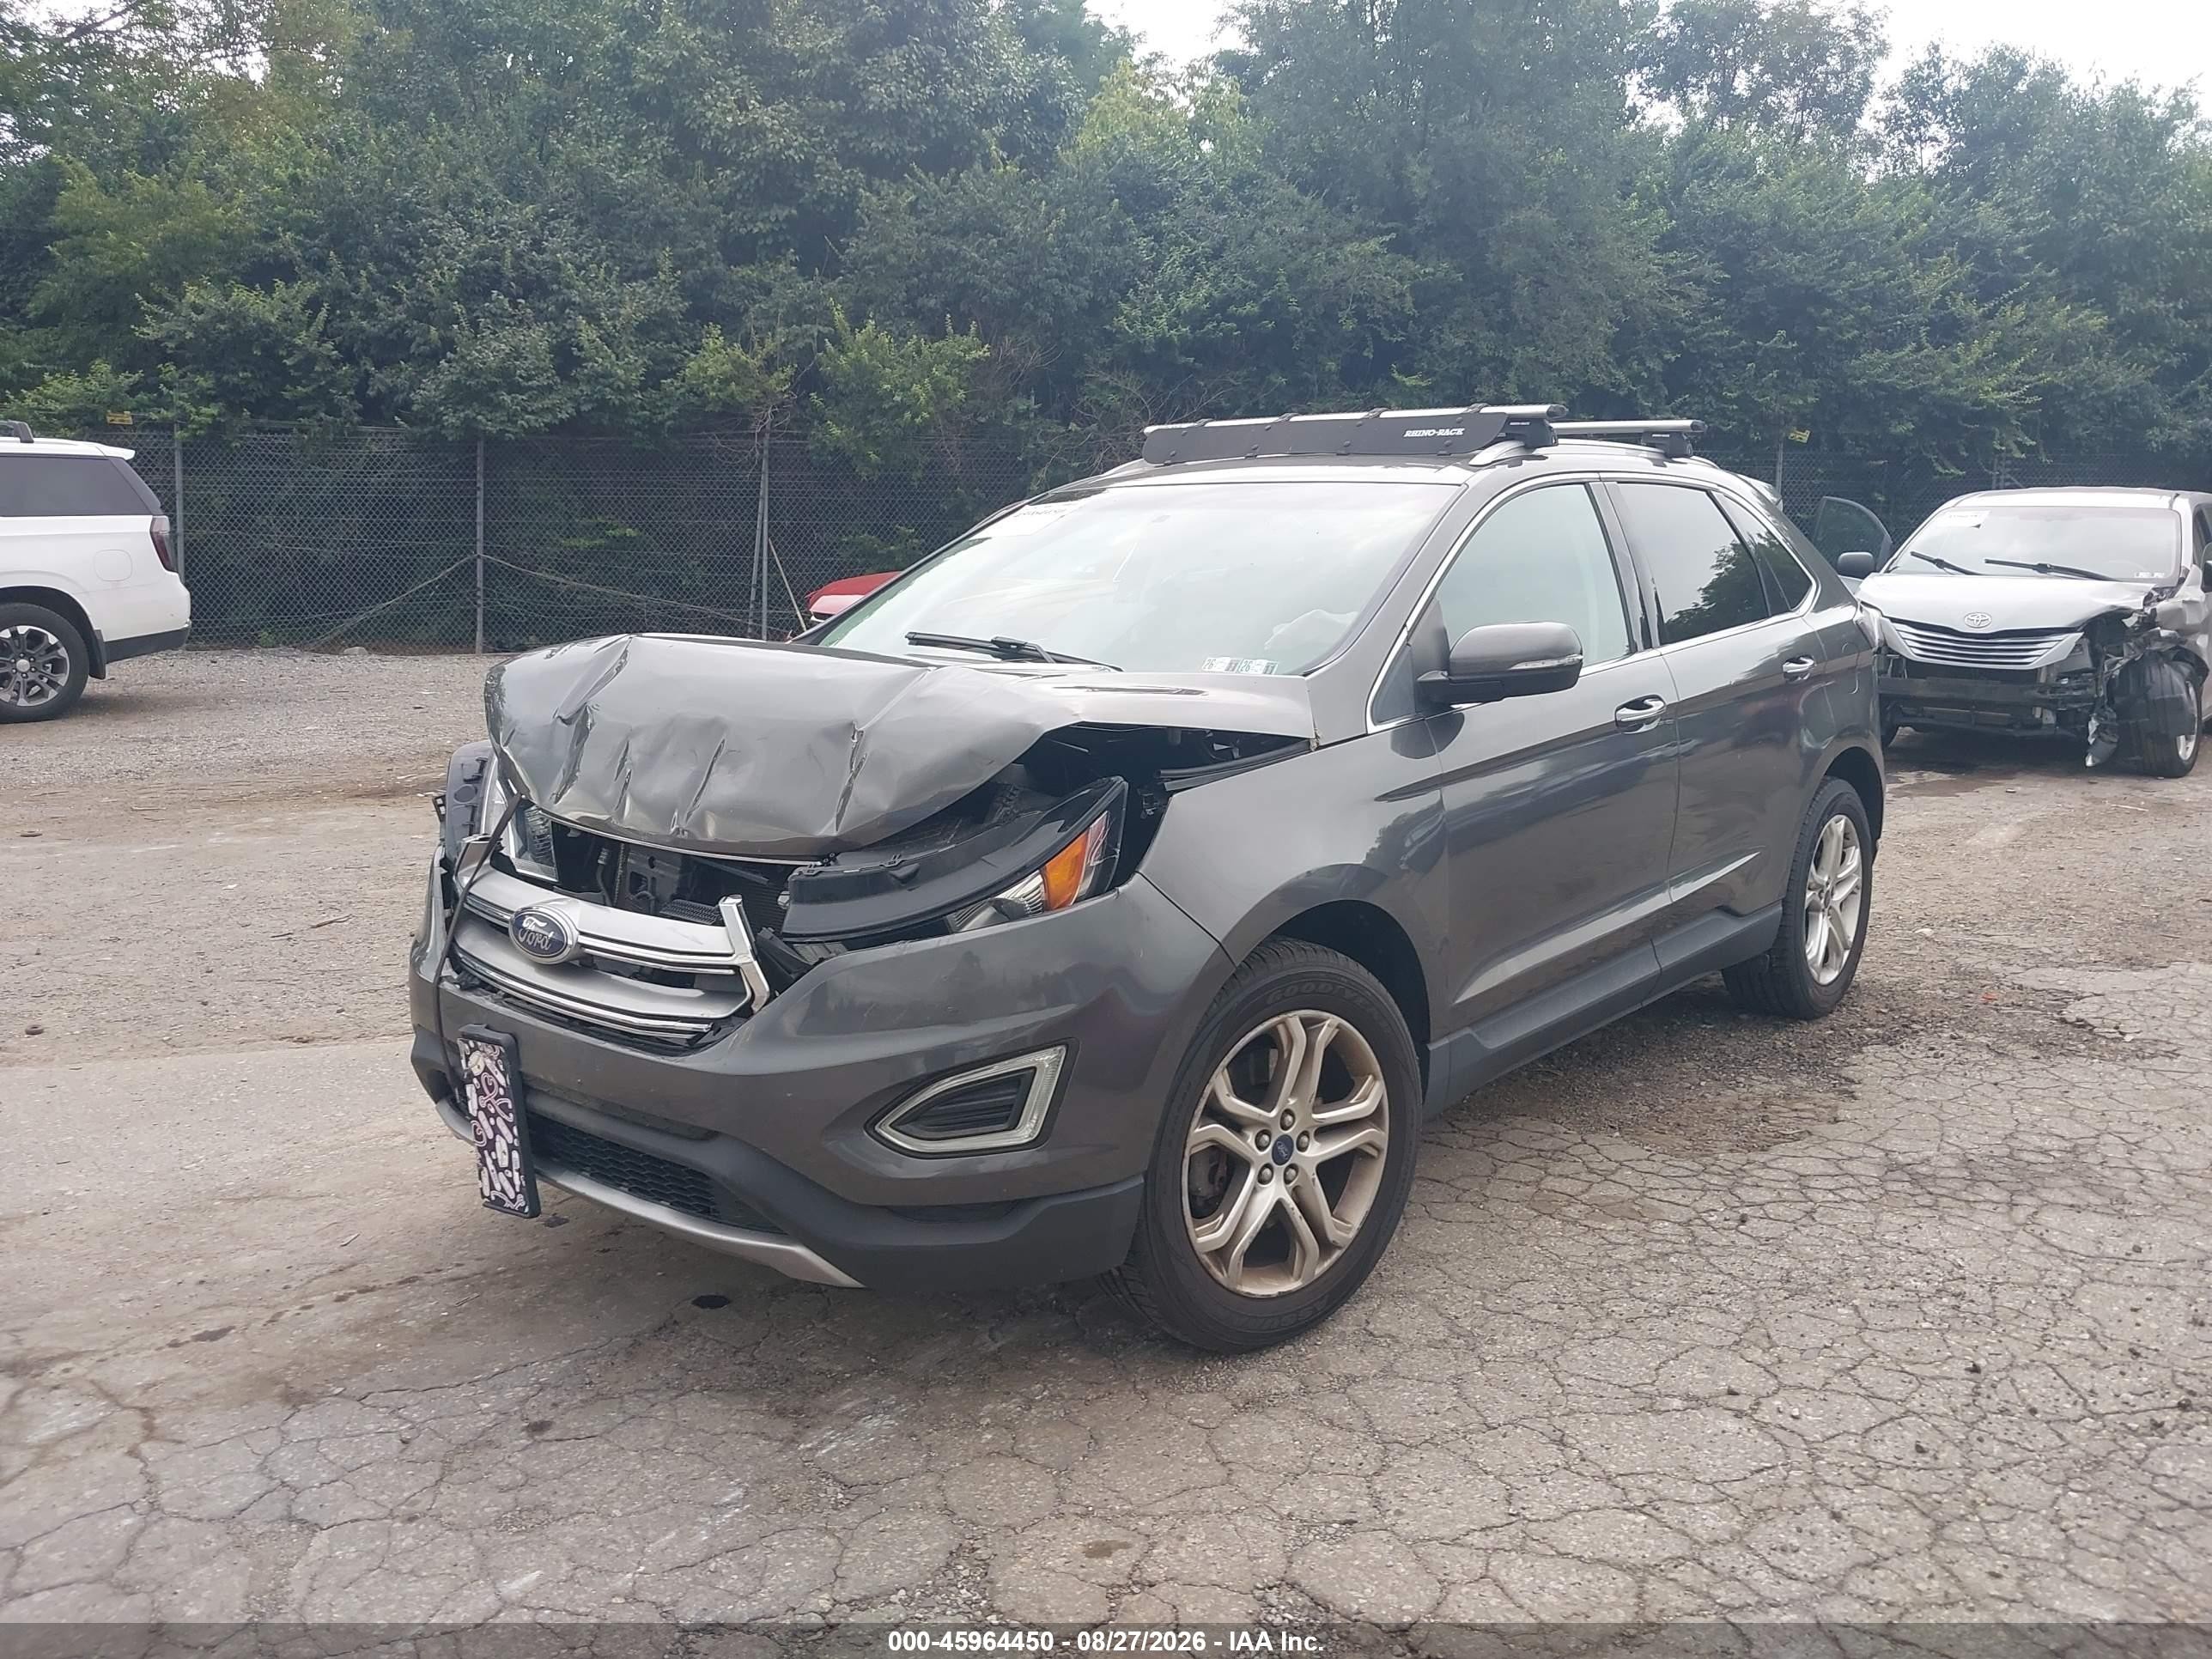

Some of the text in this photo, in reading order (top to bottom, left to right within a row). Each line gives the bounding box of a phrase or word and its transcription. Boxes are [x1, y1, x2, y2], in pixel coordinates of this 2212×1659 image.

[1403, 428, 1465, 438] RHINO-RACK
[1240, 660, 1253, 672] 26
[518, 915, 555, 951] Ford
